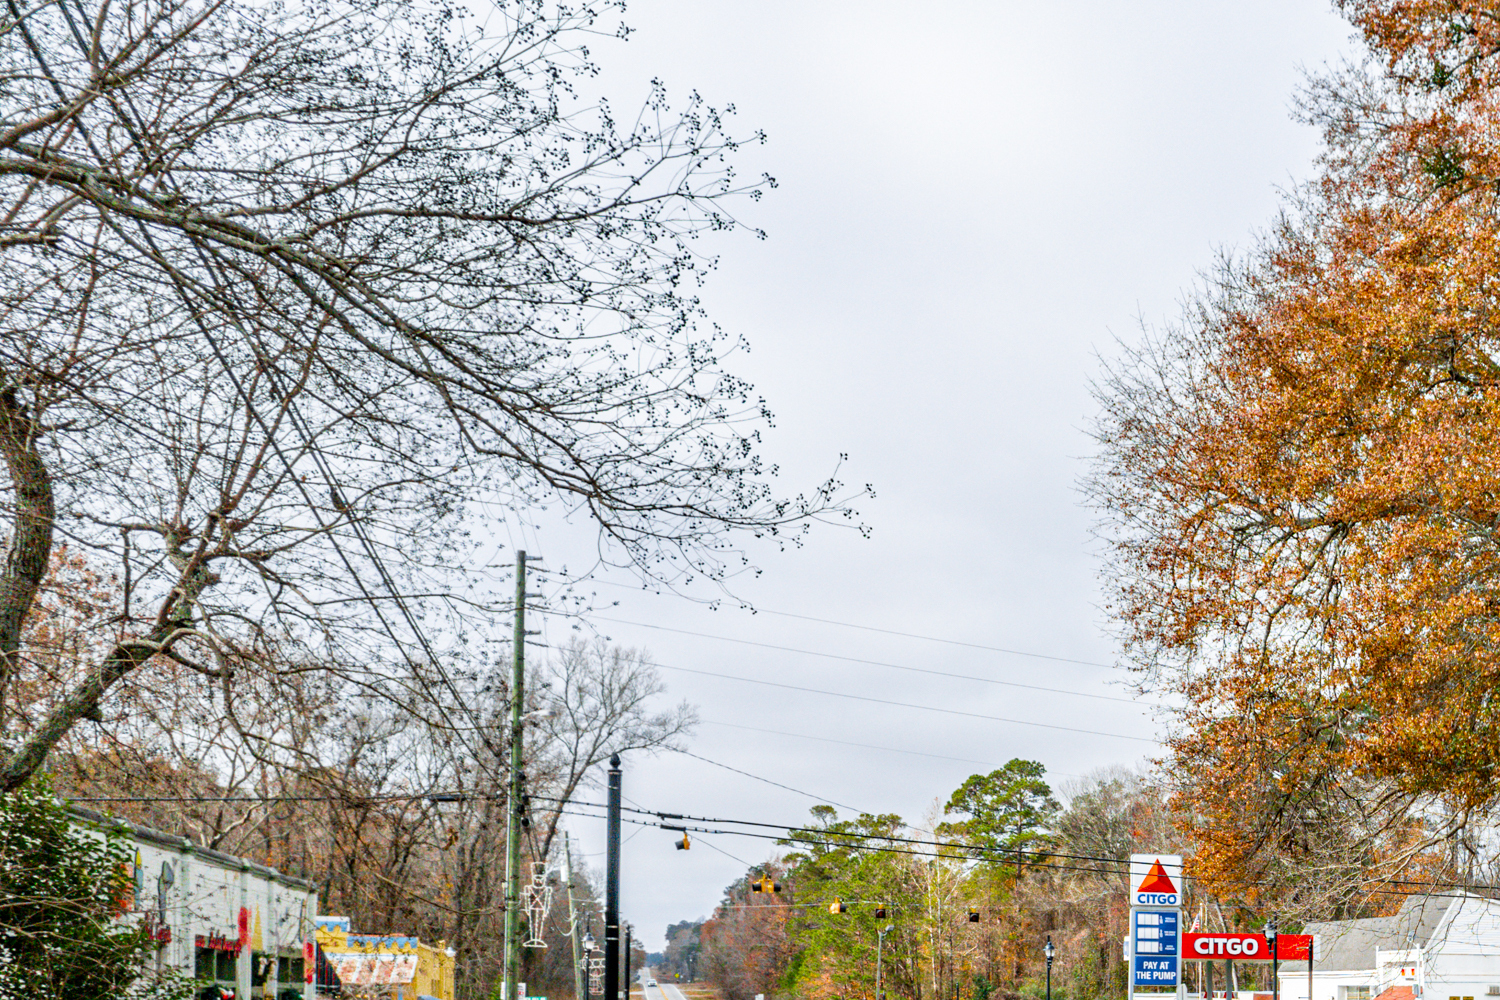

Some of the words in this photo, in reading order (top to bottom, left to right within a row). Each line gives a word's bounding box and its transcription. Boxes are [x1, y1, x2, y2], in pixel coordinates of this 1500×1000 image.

[1137, 894, 1177, 905] CITGO
[1194, 937, 1259, 955] CITGO
[1143, 961, 1158, 970] PAY
[1159, 961, 1170, 970] AT
[1136, 971, 1152, 980] THE
[1153, 971, 1177, 980] PUMP
